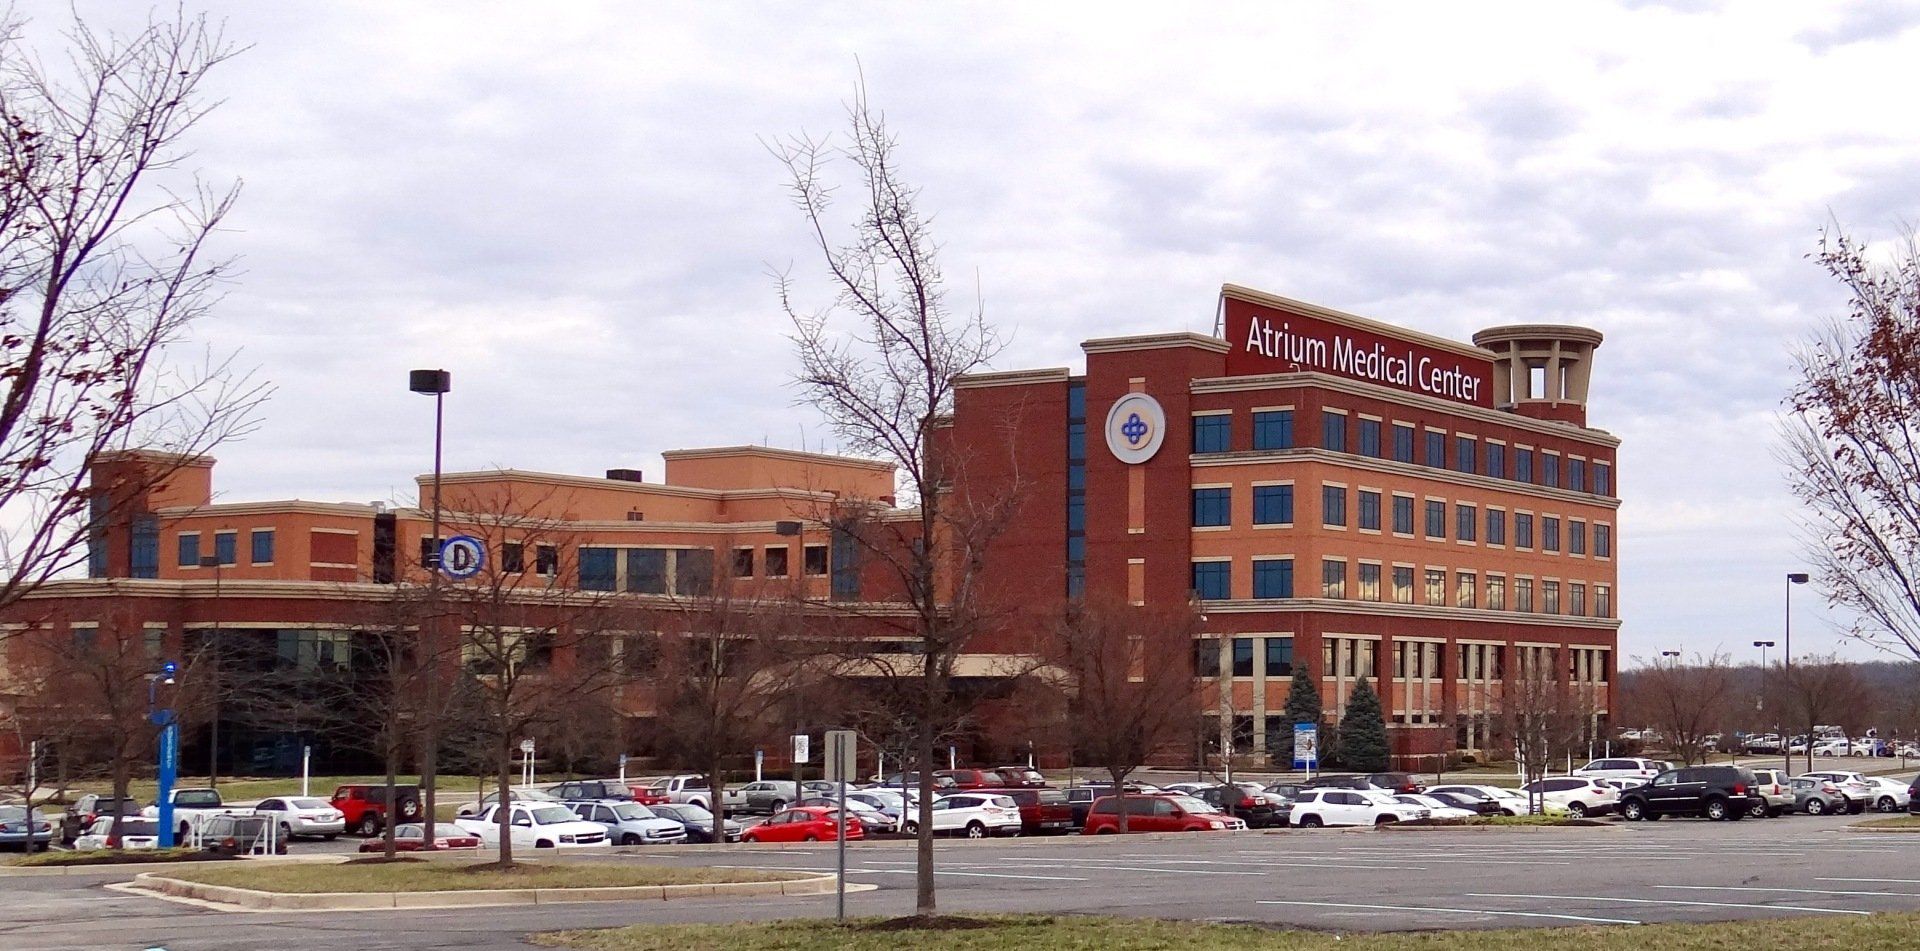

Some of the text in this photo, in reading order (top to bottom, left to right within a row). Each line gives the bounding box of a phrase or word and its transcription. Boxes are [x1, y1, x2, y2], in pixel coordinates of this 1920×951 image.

[1246, 316, 1481, 401] Atrium Medical Center
[453, 543, 471, 571] D
